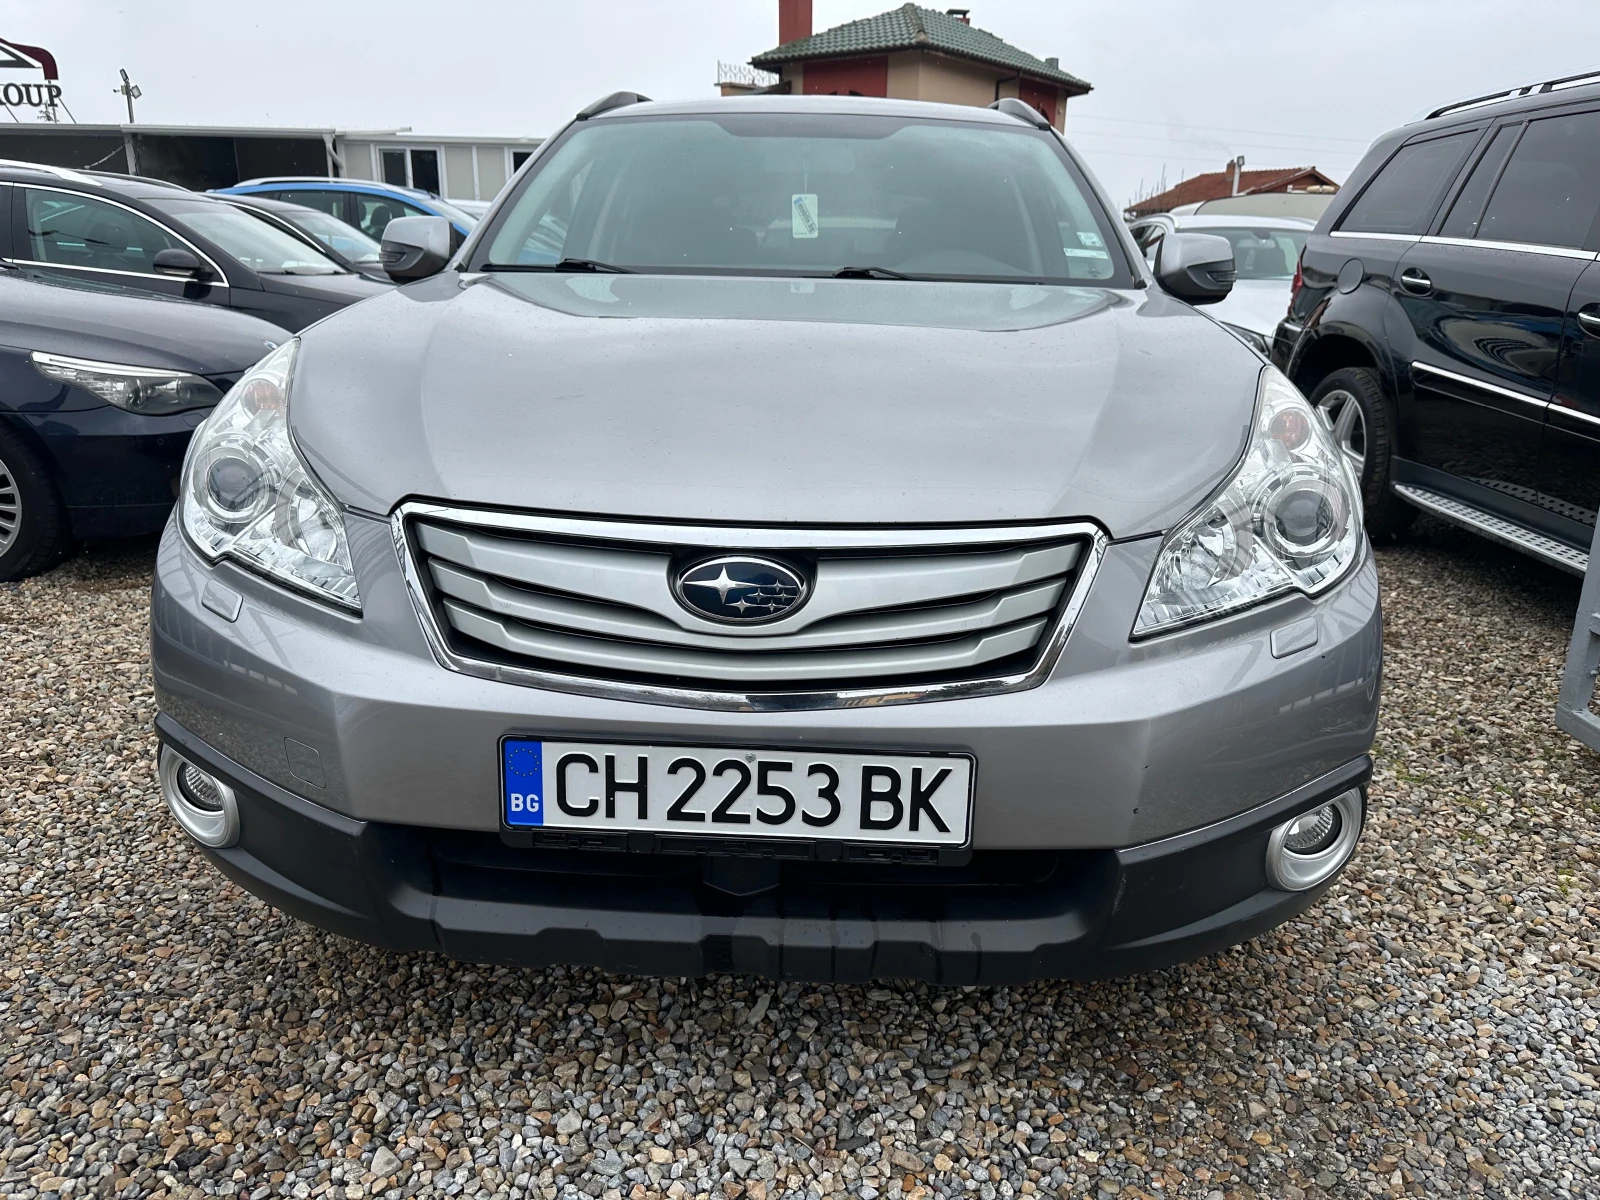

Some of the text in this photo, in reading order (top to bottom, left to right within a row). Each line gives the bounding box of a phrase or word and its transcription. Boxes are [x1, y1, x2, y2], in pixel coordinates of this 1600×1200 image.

[511, 793, 540, 812] BG
[555, 752, 951, 833] CH 2253 BK
